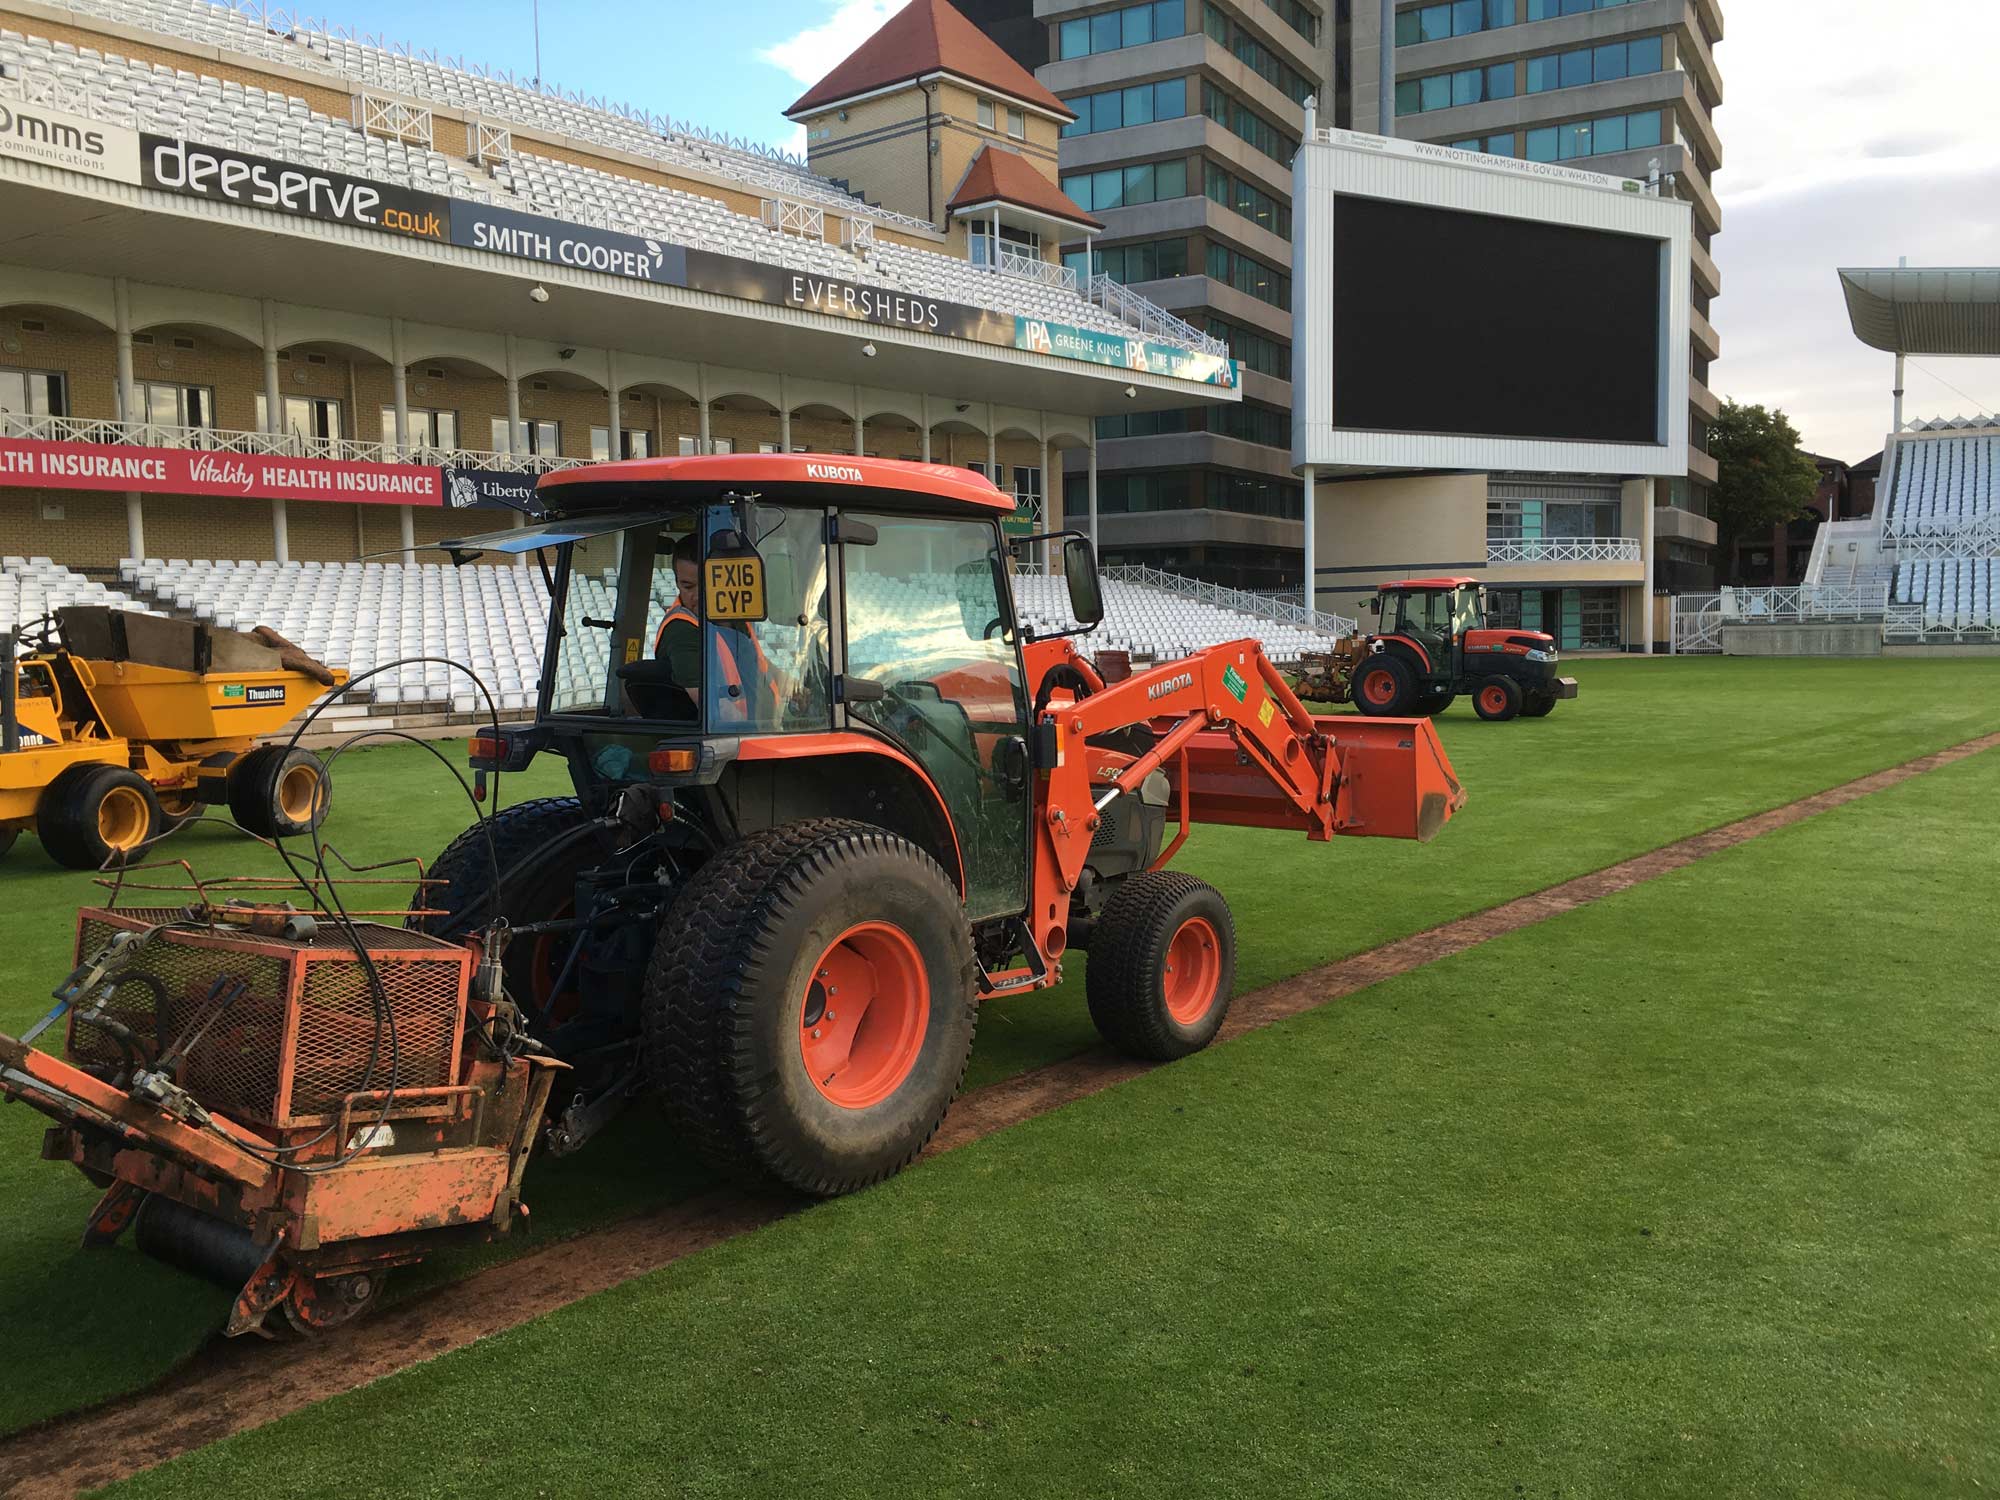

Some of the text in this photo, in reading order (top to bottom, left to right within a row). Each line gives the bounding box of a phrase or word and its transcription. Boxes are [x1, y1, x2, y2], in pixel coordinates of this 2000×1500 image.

[473, 222, 651, 279] SMITH COOPER
[792, 276, 939, 328] EVERSHEDS
[1025, 321, 1053, 350] IPA
[1055, 334, 1094, 353] GREENE
[1096, 341, 1121, 358] KING
[1124, 341, 1149, 372] IPA
[1214, 359, 1234, 384] IPA
[41, 453, 167, 480] INSURANCE
[190, 454, 254, 493] Vitality
[262, 467, 331, 490] HEALTH
[337, 471, 434, 495] INSURANCE
[806, 464, 864, 482] KUBOTA
[482, 482, 532, 504] Liberty
[711, 564, 754, 588] FX16
[715, 590, 753, 613] CYP
[1148, 672, 1193, 699] KUBOTA
[18, 734, 44, 747] onne
